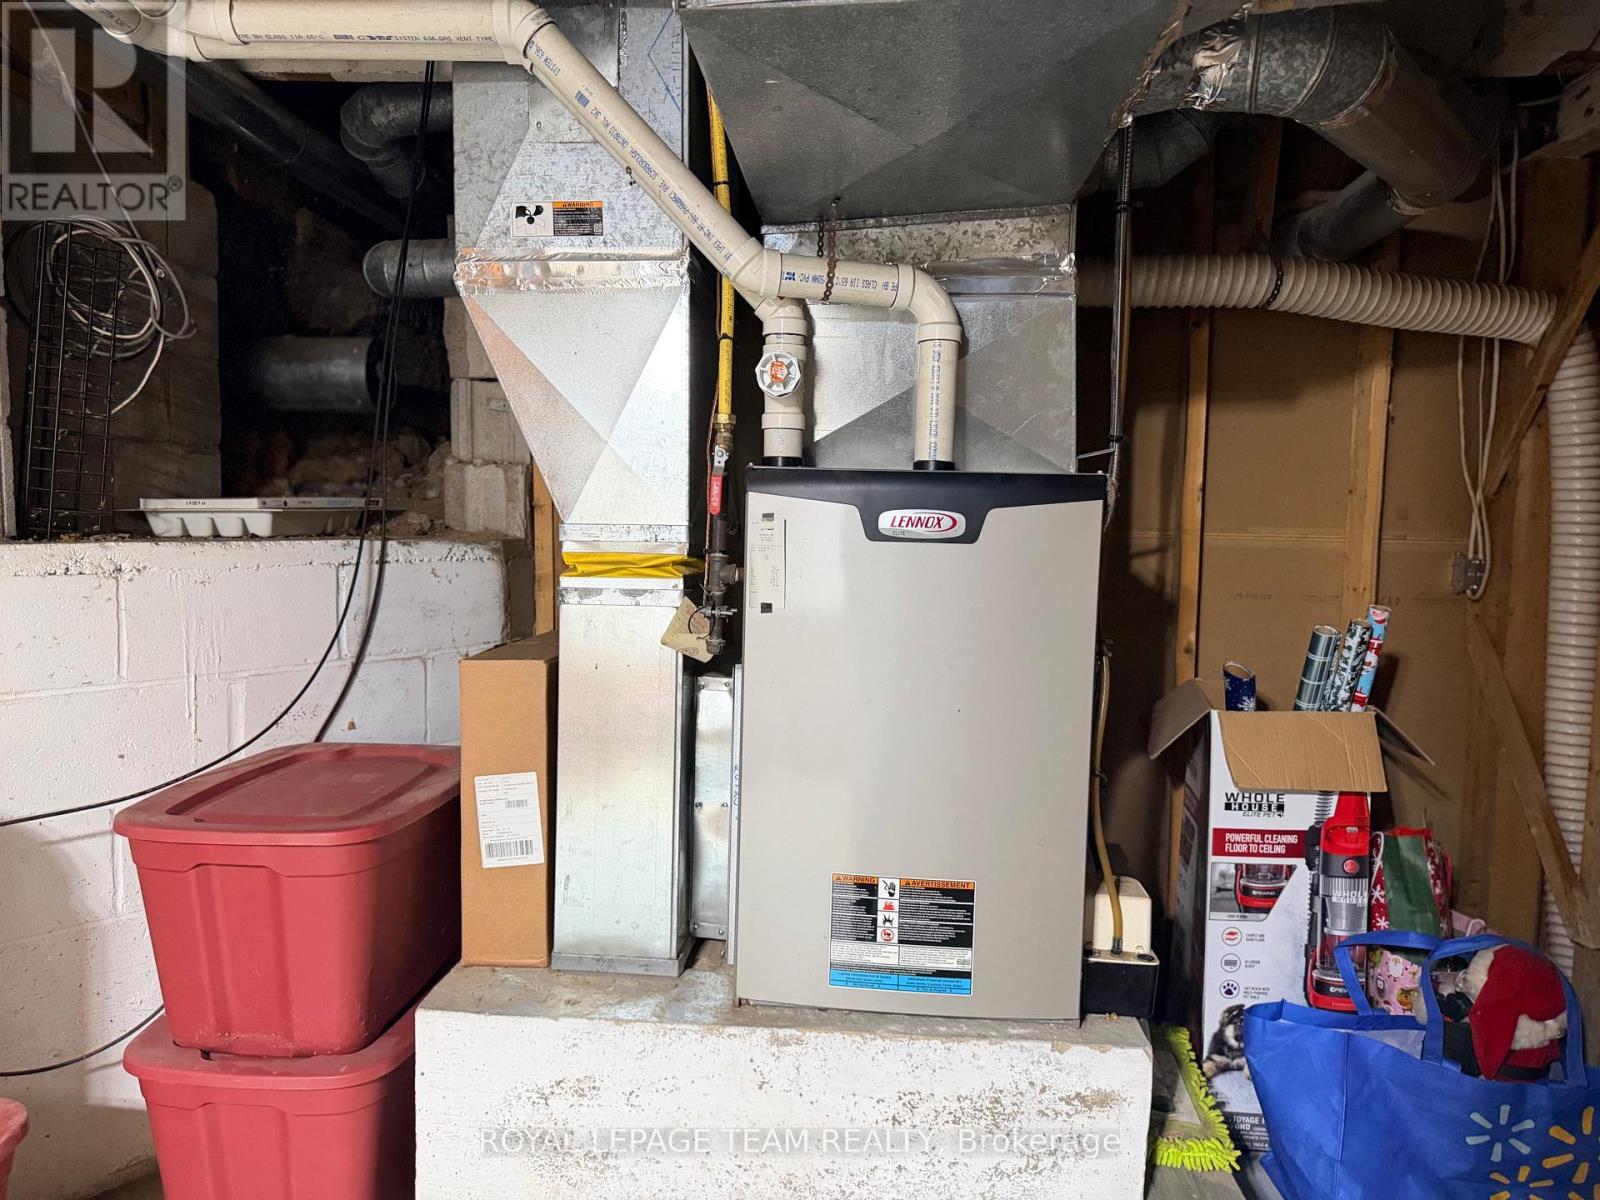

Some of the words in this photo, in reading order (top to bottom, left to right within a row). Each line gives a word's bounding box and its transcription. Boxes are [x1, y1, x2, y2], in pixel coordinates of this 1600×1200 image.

[543, 56, 562, 76] SYSTEM
[608, 126, 629, 148] ONTARIO
[861, 279, 877, 289] CLASS
[890, 516, 944, 529] LENNOX
[1225, 792, 1285, 803] WHOLE
[1231, 802, 1278, 811] HOUSE
[1225, 833, 1263, 843] POWERFUL
[1264, 834, 1298, 844] CLEANING
[1225, 843, 1249, 853] FLOOR
[1249, 844, 1258, 853] TO
[1258, 844, 1286, 854] CEILING
[842, 876, 876, 884] WARNING
[911, 881, 970, 889] AVERTISSEMENT
